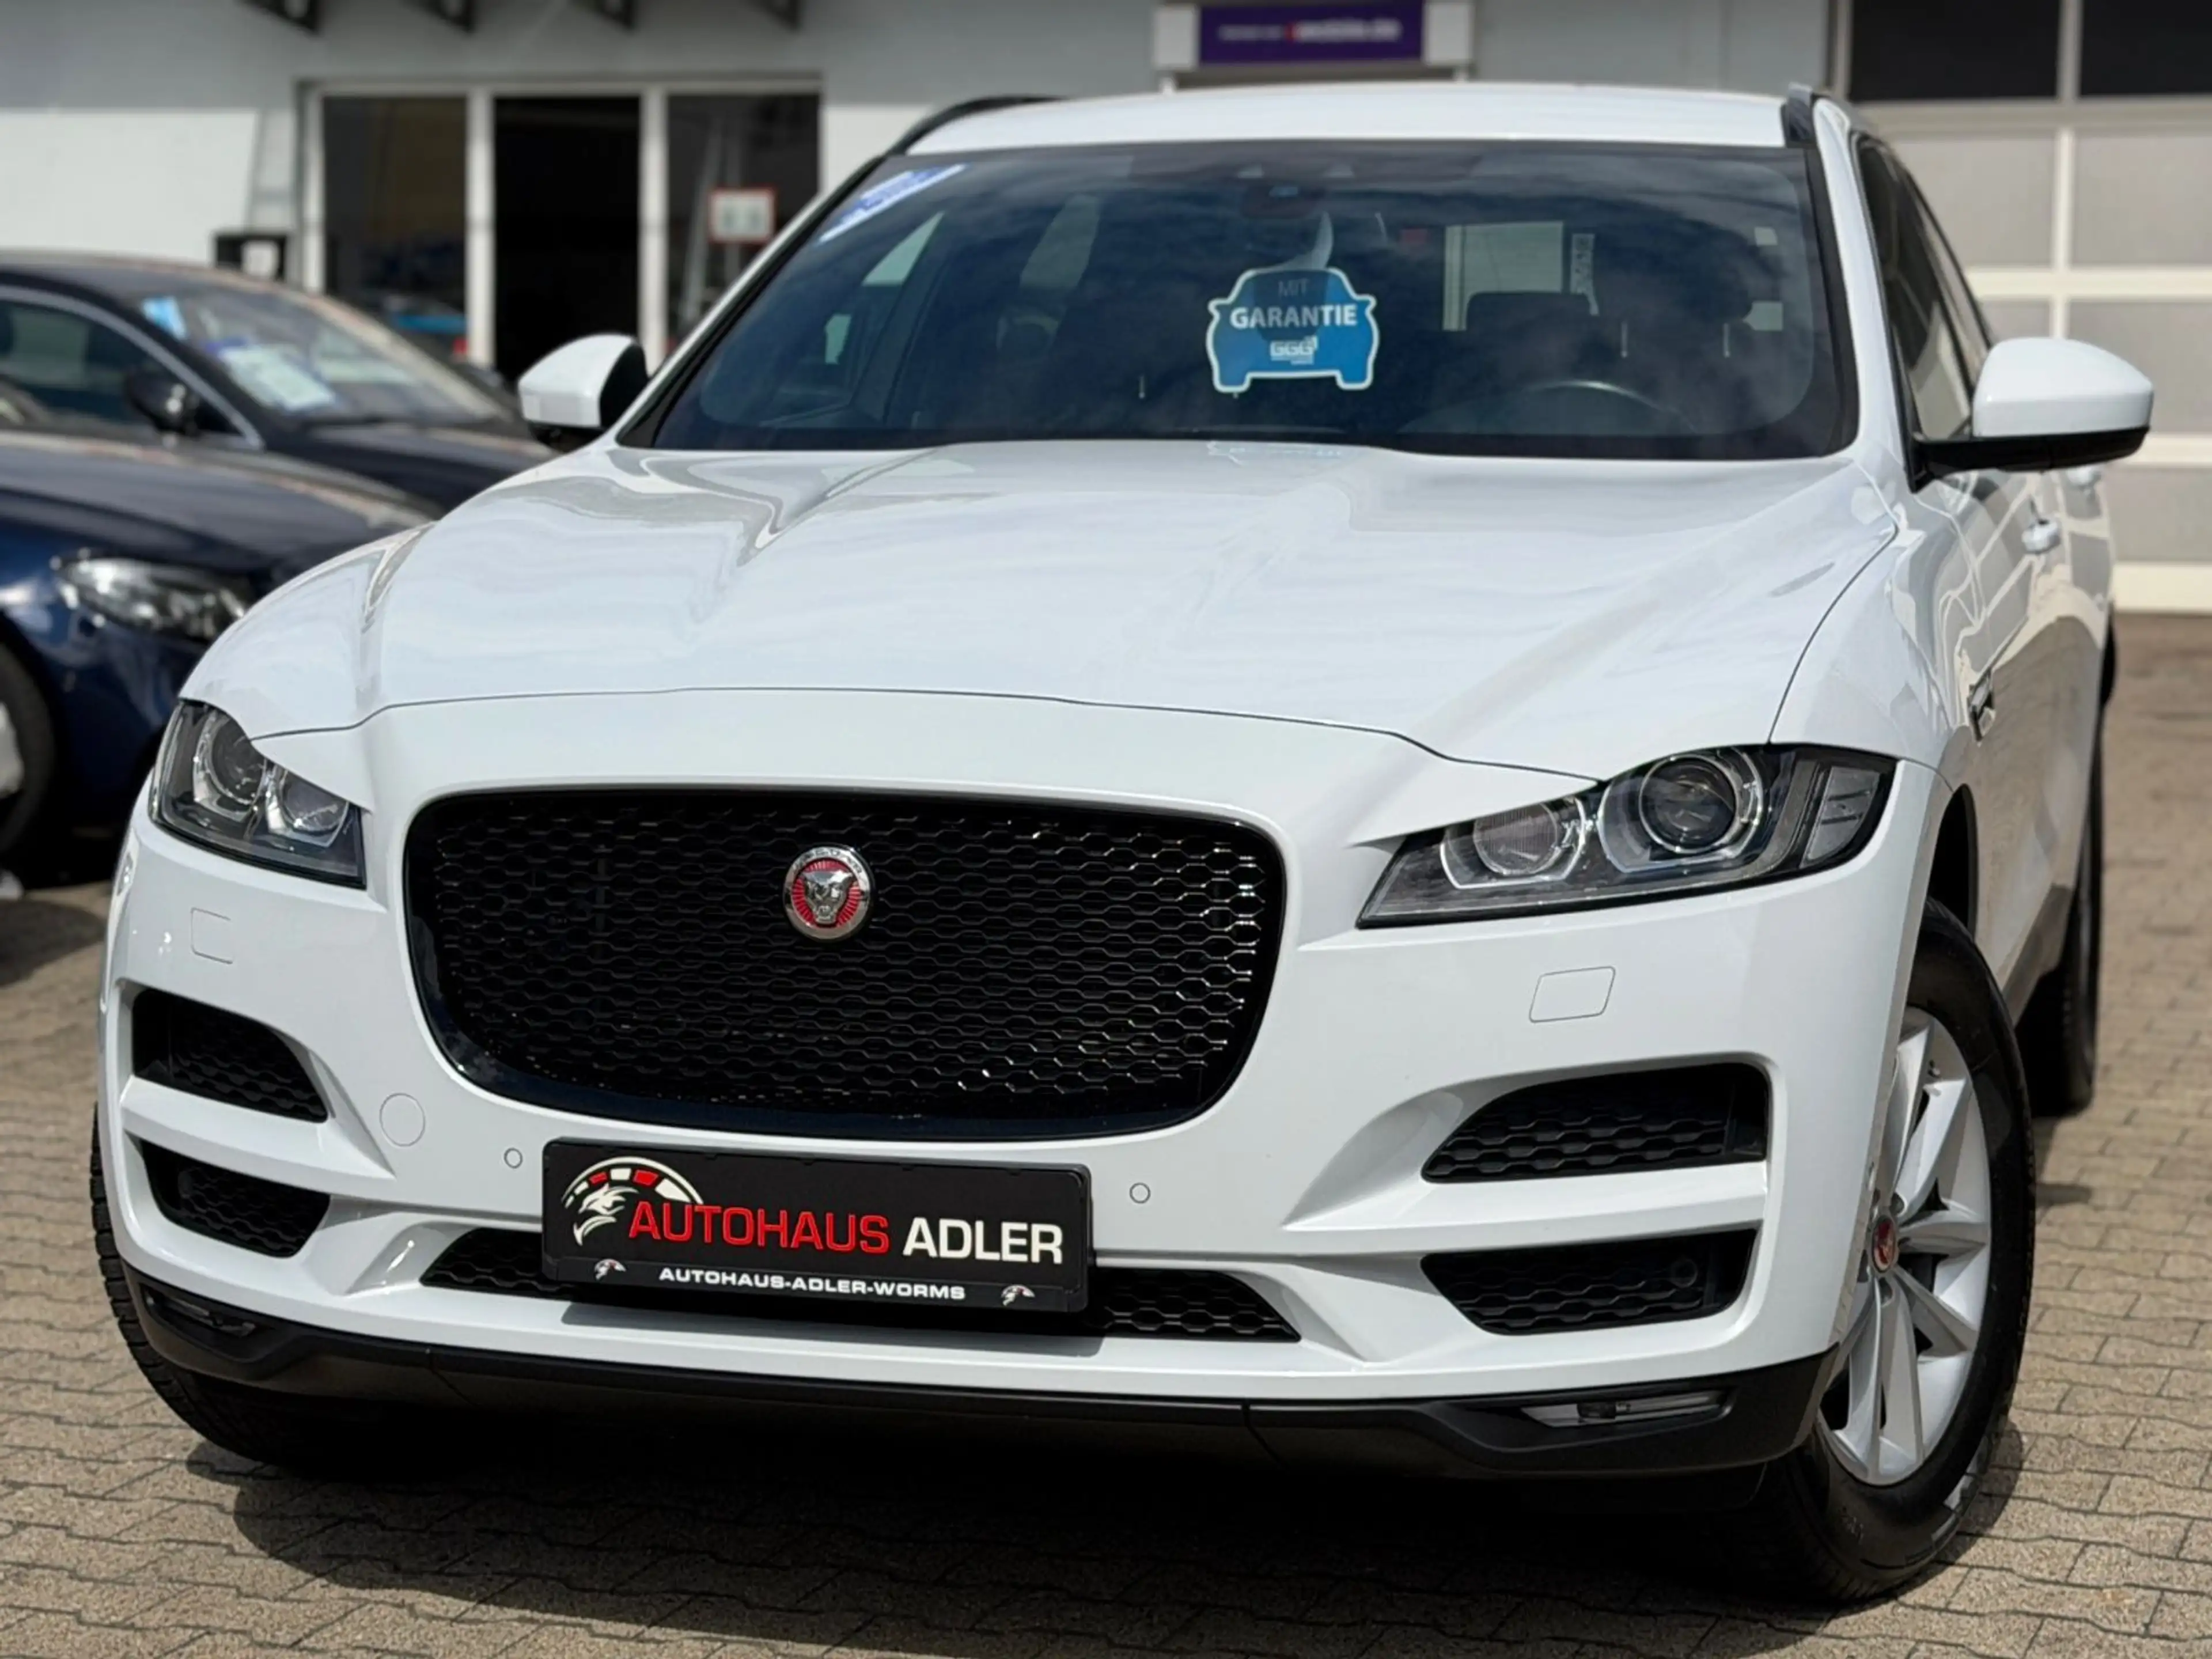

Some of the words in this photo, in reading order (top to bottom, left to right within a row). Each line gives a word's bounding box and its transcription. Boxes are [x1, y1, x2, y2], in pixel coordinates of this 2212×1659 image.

[1278, 277, 1310, 298] MIT
[1230, 304, 1358, 329] GARANTIE
[628, 1200, 891, 1255] AUTOHAUS
[902, 1217, 1063, 1264] ADLER
[658, 1267, 966, 1300] AUTOHAUS-ADLER-WORMS
